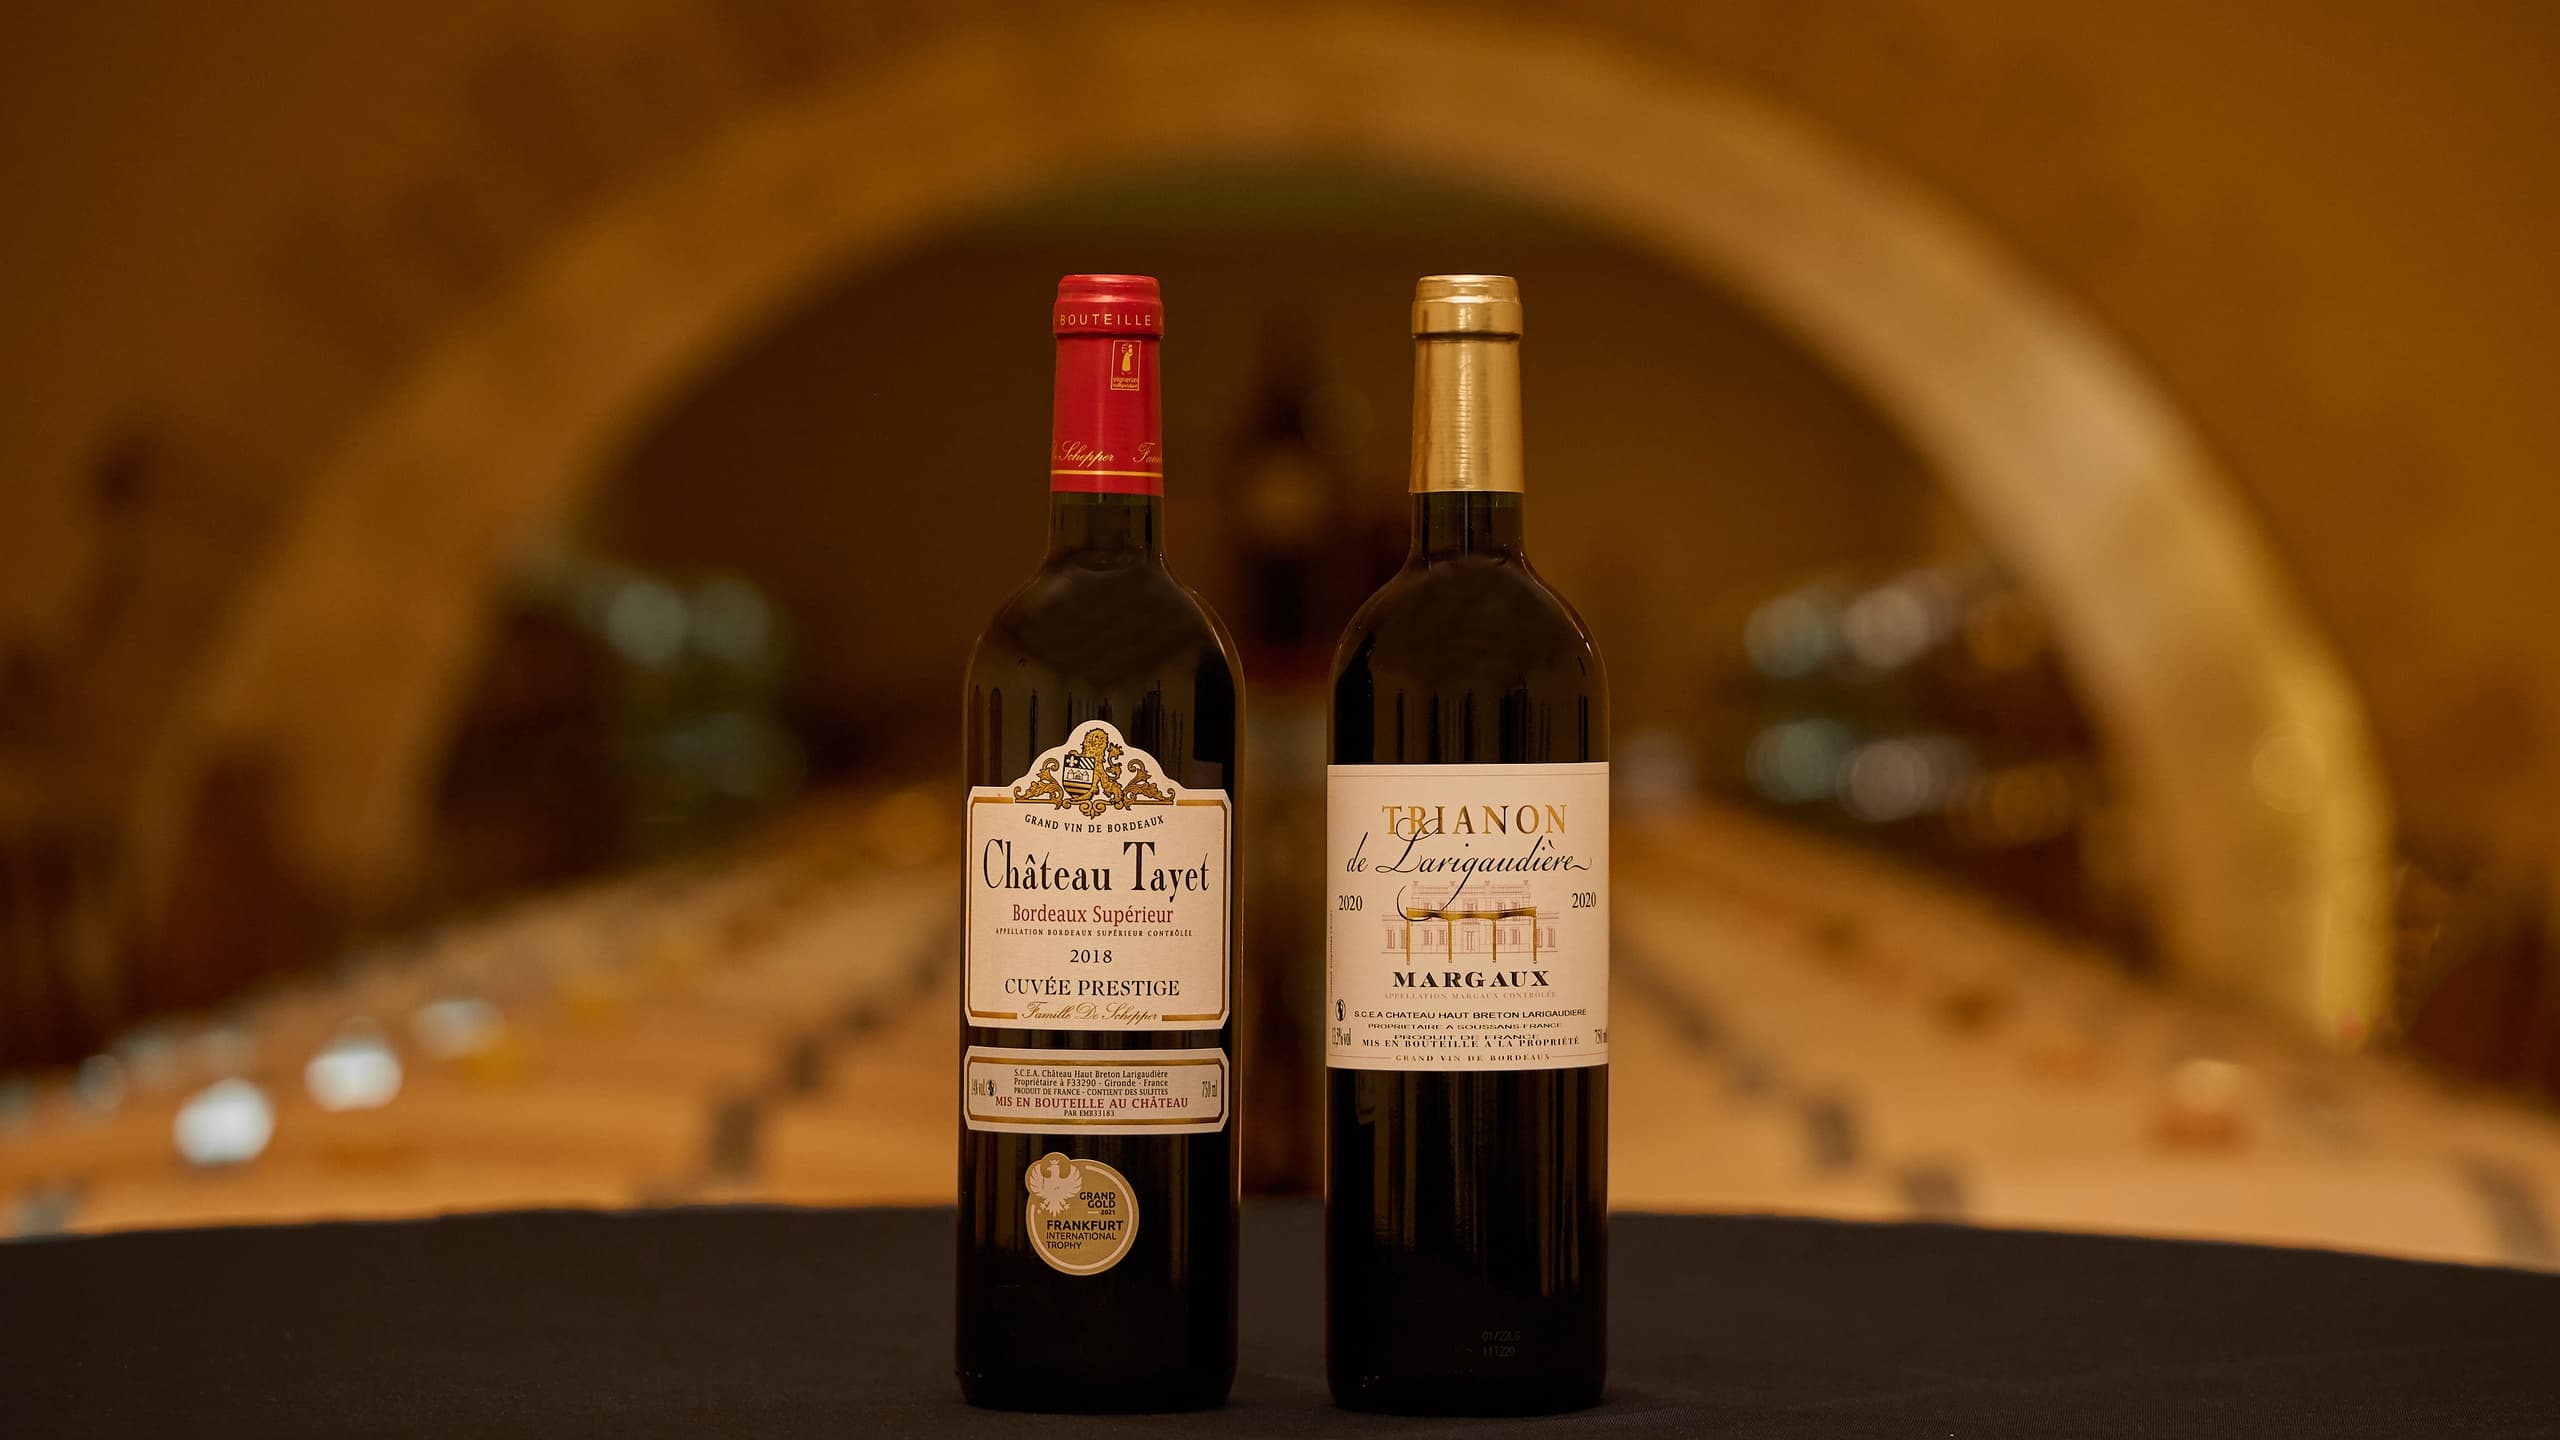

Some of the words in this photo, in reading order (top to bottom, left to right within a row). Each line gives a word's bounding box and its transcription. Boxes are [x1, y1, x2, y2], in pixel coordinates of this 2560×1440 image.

[1060, 313, 1152, 327] BOUTEILLE
[1058, 440, 1116, 468] Schepper
[1025, 813, 1059, 830] GRAND
[1064, 823, 1082, 833] VIN
[1088, 824, 1102, 834] DE
[1107, 815, 1165, 833] BORDEAUX
[1381, 804, 1568, 835] TRIANON
[983, 838, 1113, 891] Château
[1123, 841, 1210, 903] Tayet
[1346, 832, 1369, 873] de
[1375, 817, 1592, 921] Larigaudière
[1338, 894, 1363, 911] 2020
[1571, 891, 1597, 908] 2020
[1012, 903, 1087, 923] Bordeaux
[1093, 905, 1174, 927] Supérieur
[995, 928, 1043, 937] APPELLATION
[1047, 929, 1093, 937] BORDEAUX
[1096, 929, 1143, 937] SUPÉRIEUR
[1147, 928, 1193, 938] CONTRÔLÉE
[1070, 949, 1113, 964] 2018
[1393, 970, 1549, 988] MARGAUX
[1005, 975, 1071, 996] CUVÉE
[1078, 979, 1180, 997] PRESTIGE
[1384, 991, 1447, 1000] APPELLATION
[1452, 991, 1499, 1000] MARGAUX
[1021, 1001, 1075, 1019] Famille
[1075, 1001, 1098, 1019] De
[1101, 1002, 1157, 1025] Schepper
[1385, 1011, 1435, 1019] CHATEAU
[1438, 1011, 1470, 1019] HAUT
[1472, 1011, 1519, 1019] BRETON
[1522, 1008, 1587, 1018] LARIGAUDIERE
[1362, 1039, 1380, 1048] MIS
[1385, 1039, 1399, 1048] EN
[1405, 1040, 1479, 1048] BOUTEILLE
[1498, 1040, 1513, 1048] LA
[1519, 1035, 1579, 1047] PROPRIÉTÉ
[1490, 1054, 1550, 1062] BORDEAUX
[1014, 1068, 1040, 1077] S.C.E.A.
[1042, 1069, 1072, 1078] Château
[1074, 1070, 1093, 1078] Haut
[1095, 1070, 1120, 1078] Breton
[1123, 1070, 1168, 1080] Larigaudière
[1014, 1078, 1057, 1087] Propriétaire
[1060, 1079, 1065, 1087] à
[1066, 1079, 1097, 1087] F33290
[1104, 1079, 1136, 1087] Gironde
[1143, 1079, 1169, 1087] France
[1014, 1087, 1041, 1095] PRODUIT
[1043, 1088, 1051, 1096] DE
[1053, 1088, 1081, 1096] FRANCE
[1087, 1088, 1122, 1096] CONTIENT
[1124, 1088, 1138, 1096] DES
[1139, 1088, 1169, 1096] SULFITES
[995, 1096, 1013, 1107] MIS
[1016, 1097, 1030, 1107] EN
[1035, 1098, 1104, 1109] BOUTEILLE
[1109, 1098, 1127, 1109] AU
[1131, 1096, 1188, 1109] CHÂTEAU
[1063, 1109, 1077, 1117] PAR
[1079, 1191, 1116, 1200] GRAND
[1087, 1200, 1116, 1209] GOLD
[1047, 1219, 1124, 1231] FRANKFURT
[1046, 1231, 1117, 1240] INTERNATIONAL
[1046, 1241, 1082, 1249] TROPHY
